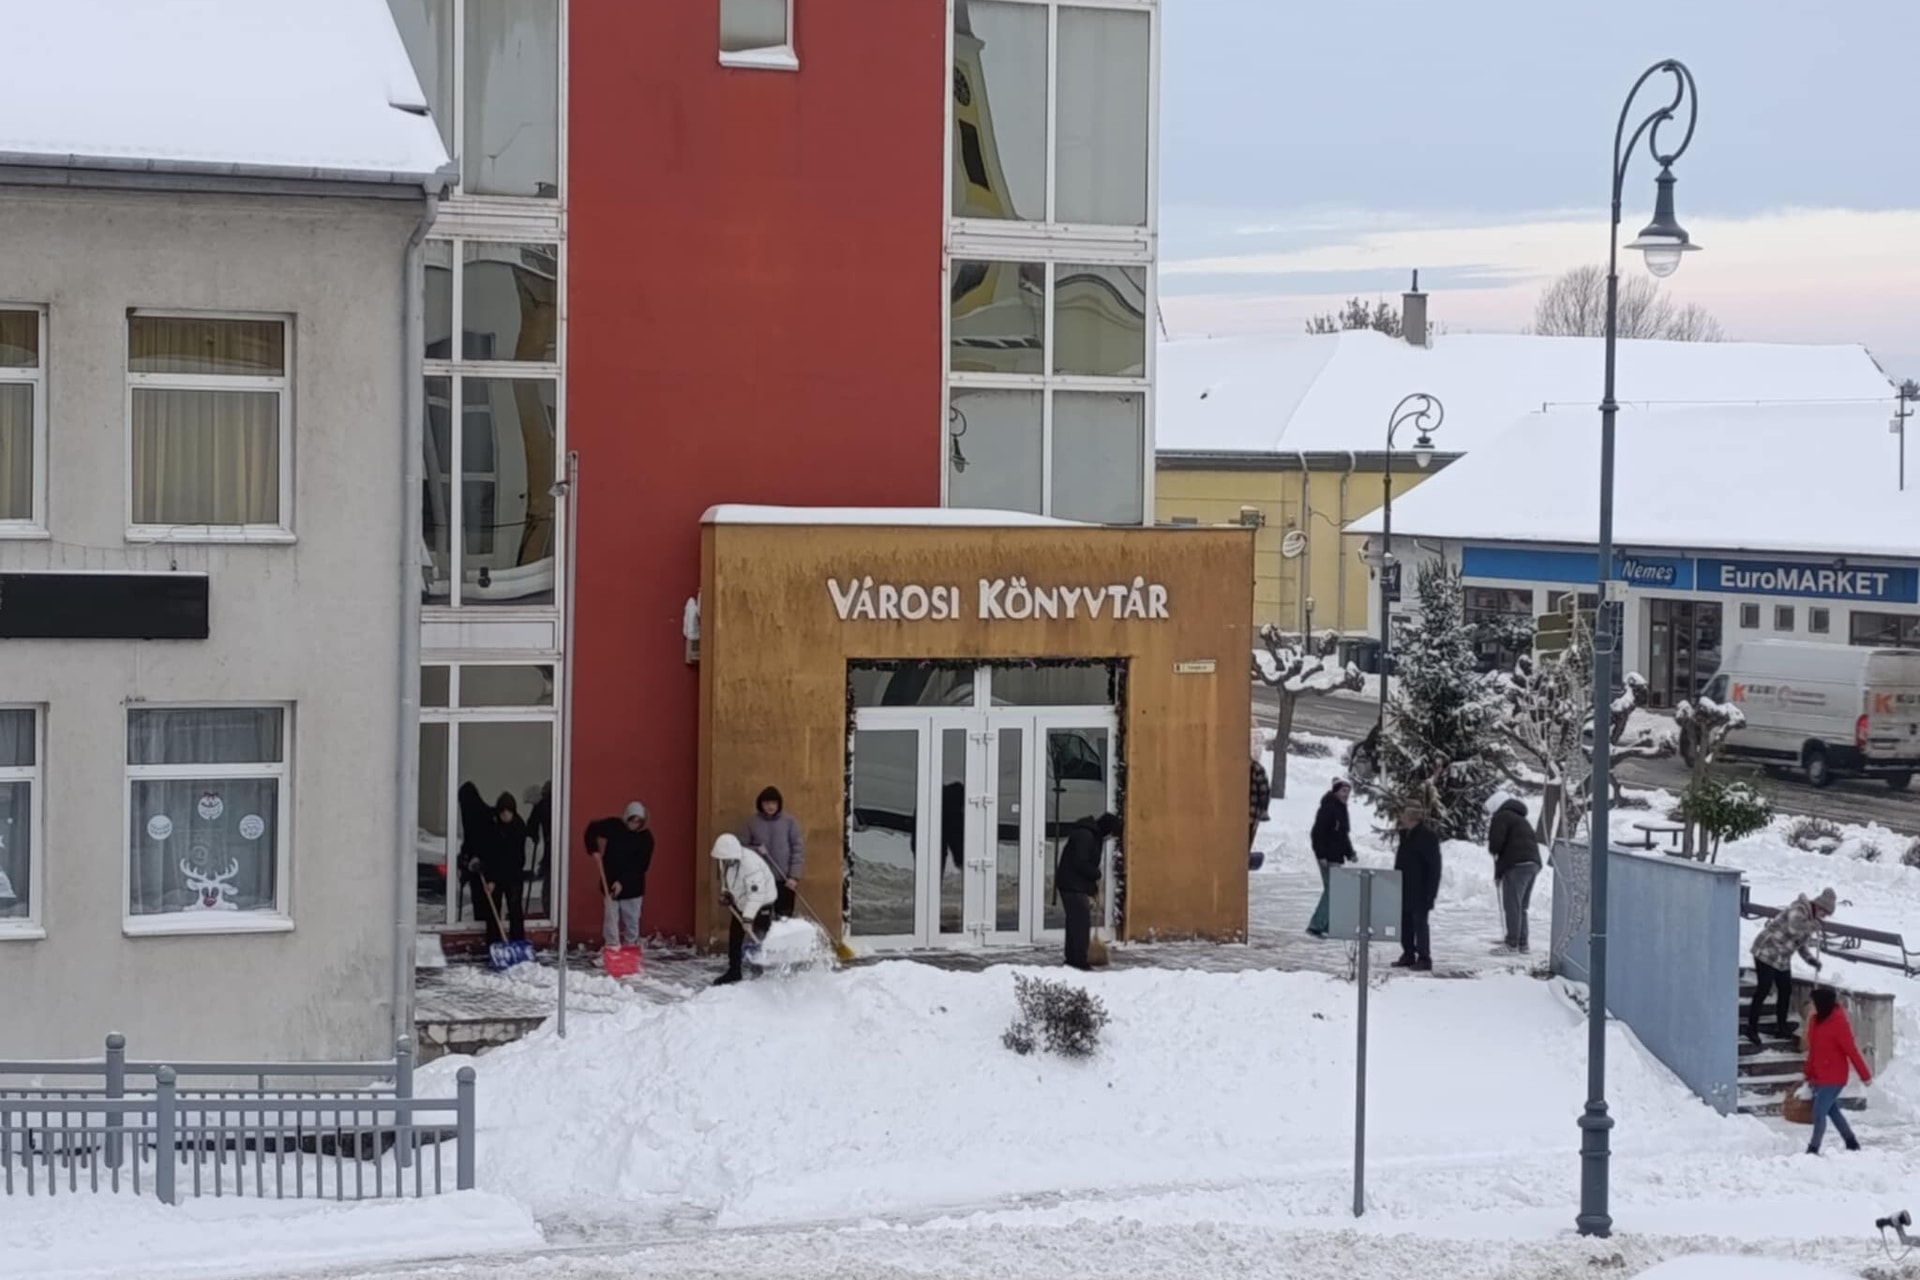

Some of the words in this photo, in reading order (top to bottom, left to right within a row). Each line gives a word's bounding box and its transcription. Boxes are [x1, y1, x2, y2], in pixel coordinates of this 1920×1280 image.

[1622, 560, 1674, 581] Nemes
[1720, 565, 1889, 596] EuroMARKET
[827, 575, 960, 620] VÁROSI
[978, 575, 1170, 620] KÖNYVTÁR
